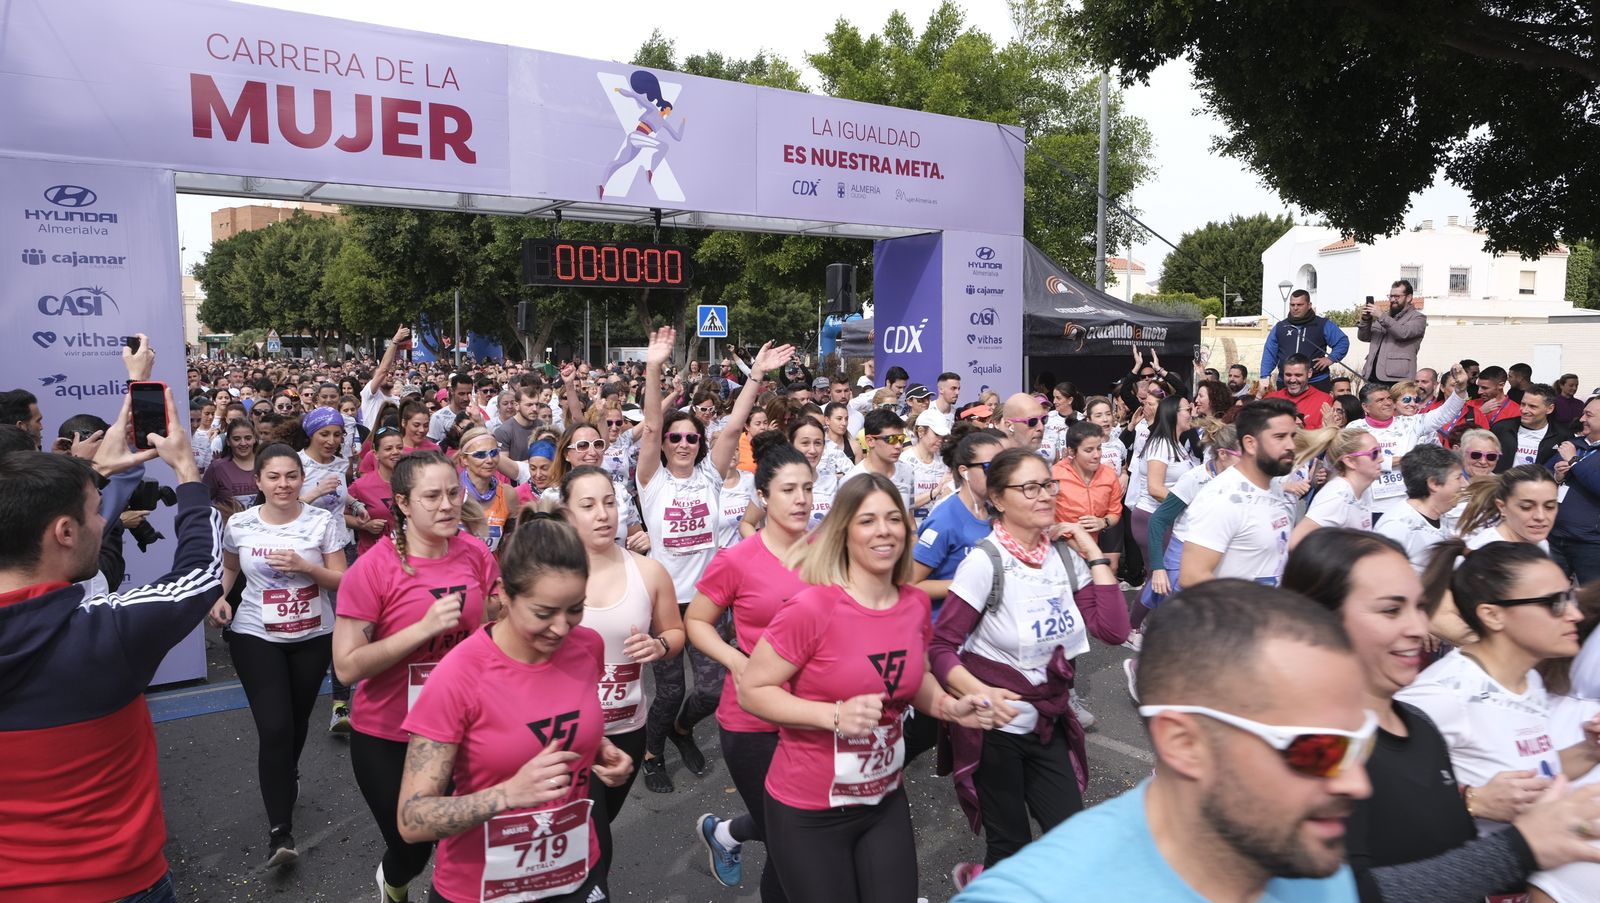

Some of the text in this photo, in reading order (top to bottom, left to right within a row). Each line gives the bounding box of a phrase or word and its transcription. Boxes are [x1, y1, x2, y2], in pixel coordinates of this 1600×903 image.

[206, 32, 461, 91] CARRERA DE LA
[189, 72, 477, 165] MUJER
[811, 117, 921, 149] LA IGUALDAD
[783, 144, 945, 180] ES NUESTRA META.
[850, 184, 881, 195] ALMERÍA
[24, 209, 118, 224] HYUNDAI
[38, 223, 109, 236] Almerialva
[51, 251, 127, 267] cajamar
[967, 261, 1003, 270] HYUNDAI
[976, 286, 1005, 296] cajamar
[37, 294, 104, 316] CASI
[969, 312, 995, 326] CASI
[62, 332, 128, 348] vithas
[883, 318, 929, 354] CDX
[977, 335, 1003, 345] vithas
[972, 363, 1002, 376] aqualia
[55, 380, 130, 400] aqualia
[1516, 447, 1538, 456] MUJE
[724, 506, 748, 516] MUJE
[809, 503, 831, 511] UJER
[669, 517, 706, 533] 2584
[276, 600, 310, 617] 942
[1031, 609, 1075, 639] 1205
[857, 746, 895, 773] 720
[513, 833, 568, 869] 719
